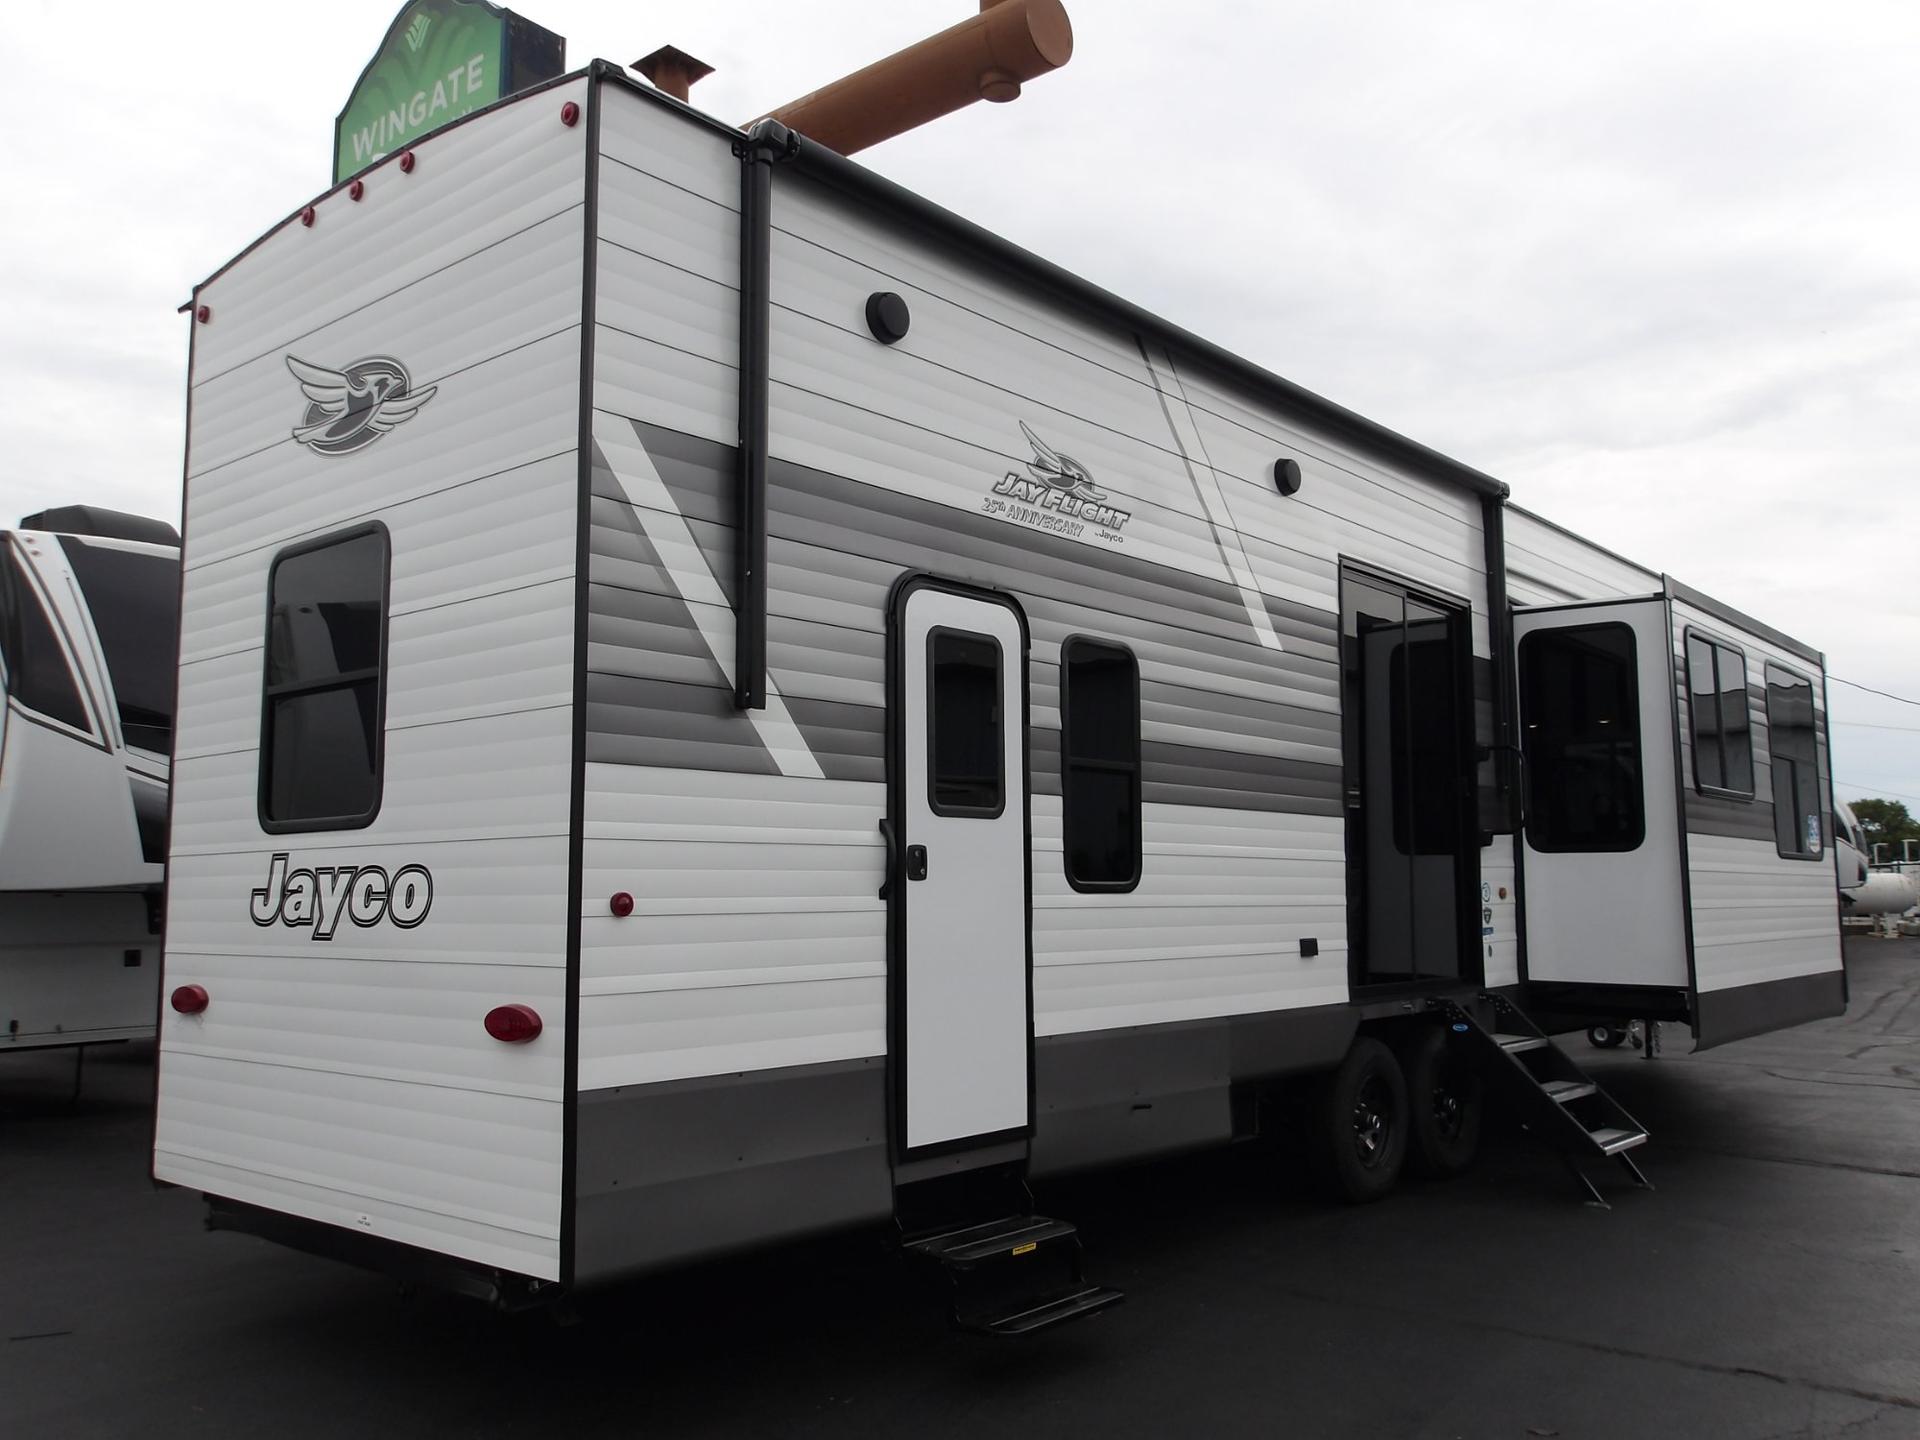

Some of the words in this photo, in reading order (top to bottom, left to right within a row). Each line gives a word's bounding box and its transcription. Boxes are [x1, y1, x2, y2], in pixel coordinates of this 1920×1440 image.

[352, 53, 484, 162] WINGATE
[981, 497, 1006, 514] 25th
[1006, 504, 1085, 538] ANNIVERSARY
[991, 471, 1048, 504] JAY
[1041, 487, 1132, 530] FLIGHT
[1099, 529, 1124, 544] Jayco
[250, 853, 433, 941] Jayco
